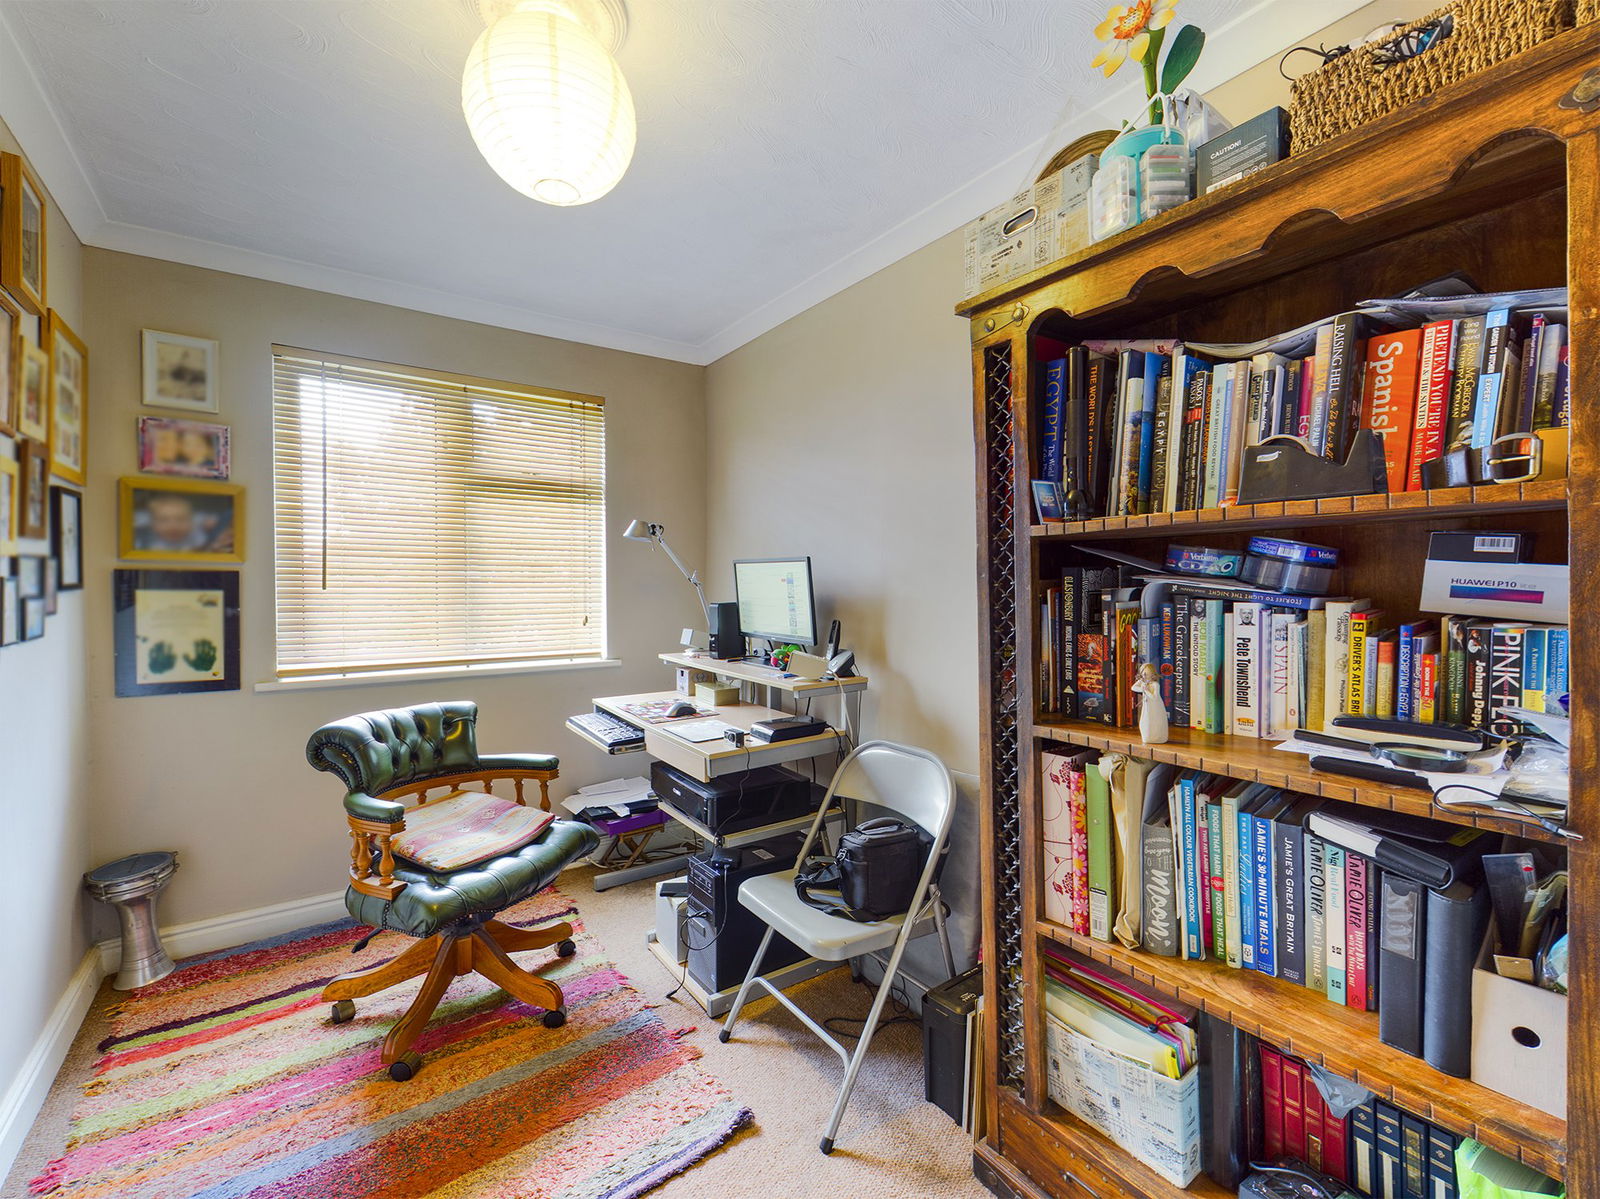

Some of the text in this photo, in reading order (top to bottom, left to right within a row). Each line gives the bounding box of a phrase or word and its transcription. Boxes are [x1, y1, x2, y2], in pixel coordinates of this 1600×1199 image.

[1210, 139, 1242, 160] CAUTION!
[1426, 329, 1434, 344] THE
[1432, 325, 1450, 382] PRETEND
[1490, 327, 1500, 346] GARDEN
[1090, 365, 1098, 384] THE
[1328, 324, 1346, 394] RAISING HELL
[1423, 348, 1432, 368] WHO
[1487, 354, 1496, 374] KITCHEN
[1189, 380, 1197, 404] PASOS
[1196, 378, 1204, 401] PASOS
[1236, 371, 1245, 400] FAMILY
[1370, 342, 1404, 441] Spanish
[1420, 376, 1429, 394] THE
[1451, 380, 1465, 418] BOORMAN
[1482, 378, 1493, 402] EXPERT
[1044, 366, 1061, 442] EGYPT
[1311, 397, 1322, 447] MICHAEL PALIN
[1417, 396, 1428, 428] SIXTIES
[1427, 383, 1444, 428] YOU'RE
[1048, 444, 1056, 457] The
[1155, 411, 1167, 455] EGYPT
[1426, 430, 1439, 445] IN
[1412, 432, 1424, 484] MARK BLAKE
[1190, 552, 1220, 562] Verbatim
[1064, 576, 1074, 622] GLASTONBURY
[1450, 578, 1496, 587] HUAWEI
[1497, 580, 1517, 588] P10
[1274, 598, 1302, 606] STORIES
[1162, 608, 1172, 659] KEN LUKOWIAK
[1335, 616, 1344, 642] Passions
[1174, 602, 1188, 694] The Gracekeepers
[1492, 632, 1522, 688] PINK
[1557, 640, 1565, 666] ALMOND
[1236, 637, 1251, 708] Pete Townshend
[1274, 644, 1288, 694] SPAIN
[1352, 636, 1362, 698] DRIVER'S ATLAS
[1400, 644, 1410, 713] DESCRIPTION EGYPT
[1472, 660, 1486, 698] Johnny
[1184, 812, 1192, 823] ALL
[1186, 824, 1194, 850] COLOUR
[1256, 822, 1266, 862] JAMIE'S
[1186, 850, 1195, 886] VEGETARIAN
[1213, 854, 1222, 875] HARM
[1239, 850, 1252, 896] Ladies
[1187, 886, 1196, 922] COOKBOOK
[1215, 892, 1223, 916] FOODS
[1258, 864, 1268, 916] 30-MINUTE
[1284, 837, 1295, 954] JAMIE'S GREAT BRITAIN
[1330, 868, 1340, 909] Real Food
[1310, 838, 1326, 978] JAMIE OLIVER JAMIE'S DINNERS
[1348, 854, 1366, 971] JAMIE OLIVER HAPPY DAYS
[1259, 918, 1269, 954] MEALS
